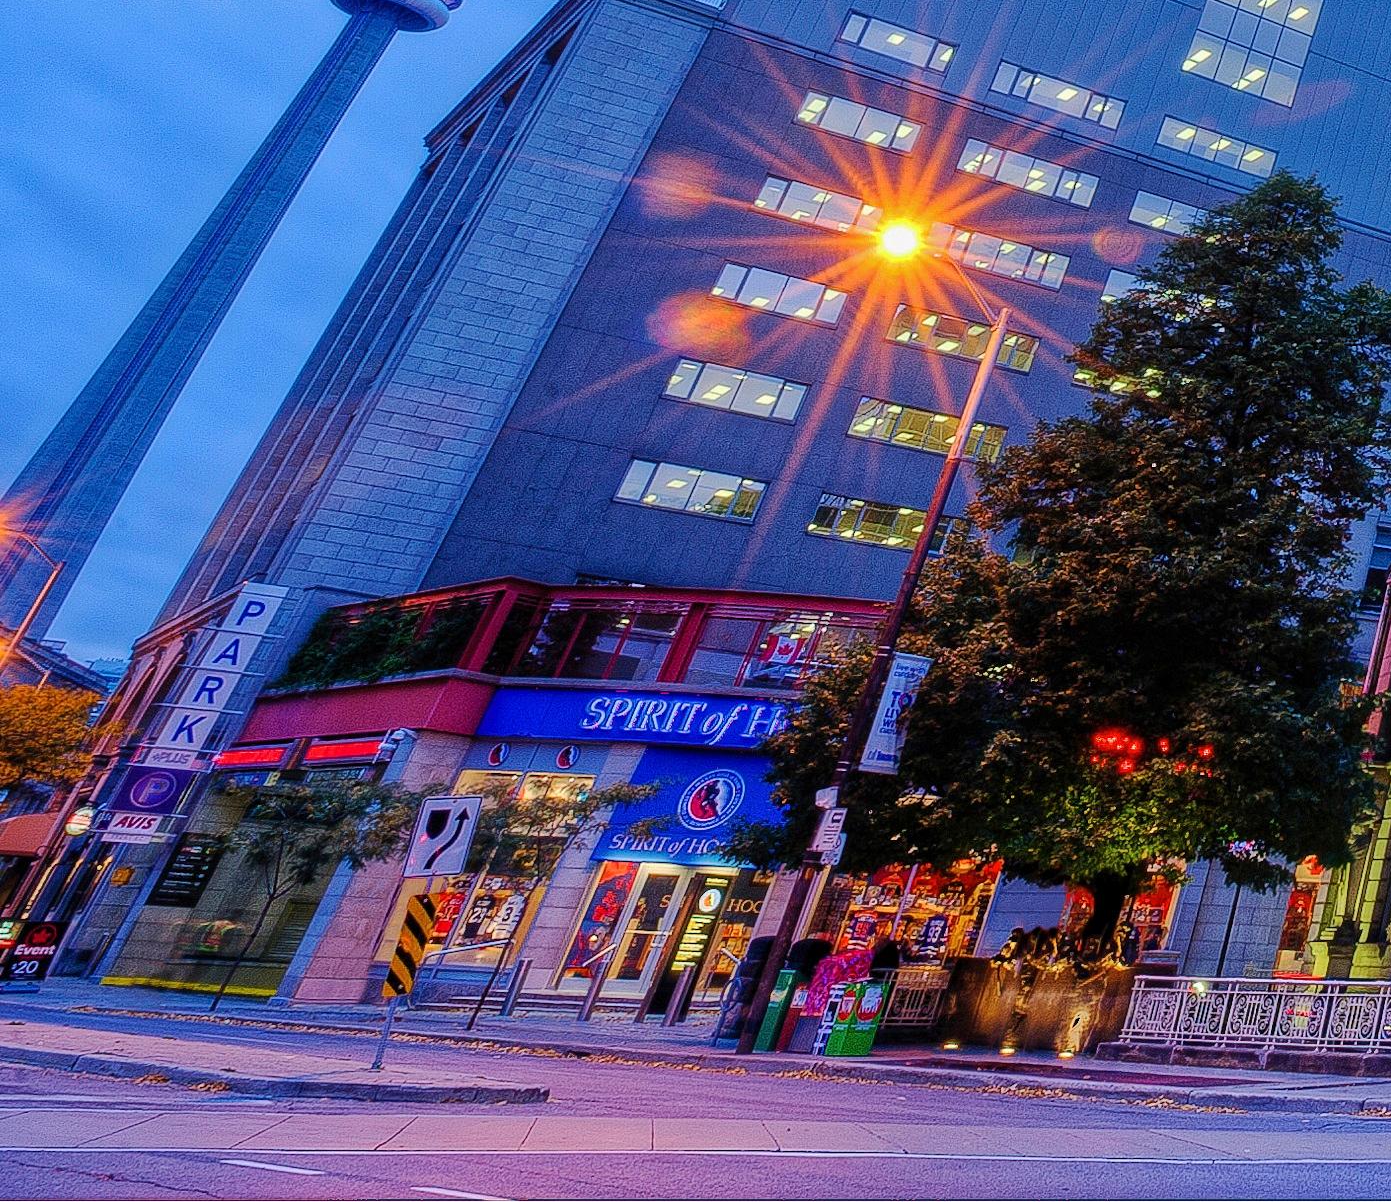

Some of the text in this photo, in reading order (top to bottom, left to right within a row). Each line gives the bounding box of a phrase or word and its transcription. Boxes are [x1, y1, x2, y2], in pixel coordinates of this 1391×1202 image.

[171, 600, 266, 744] PARK
[579, 697, 707, 734] SPIRIT
[701, 702, 748, 746] of
[113, 815, 157, 830] AVIS
[609, 833, 672, 852] SPIRIT
[14, 943, 56, 955] Event
